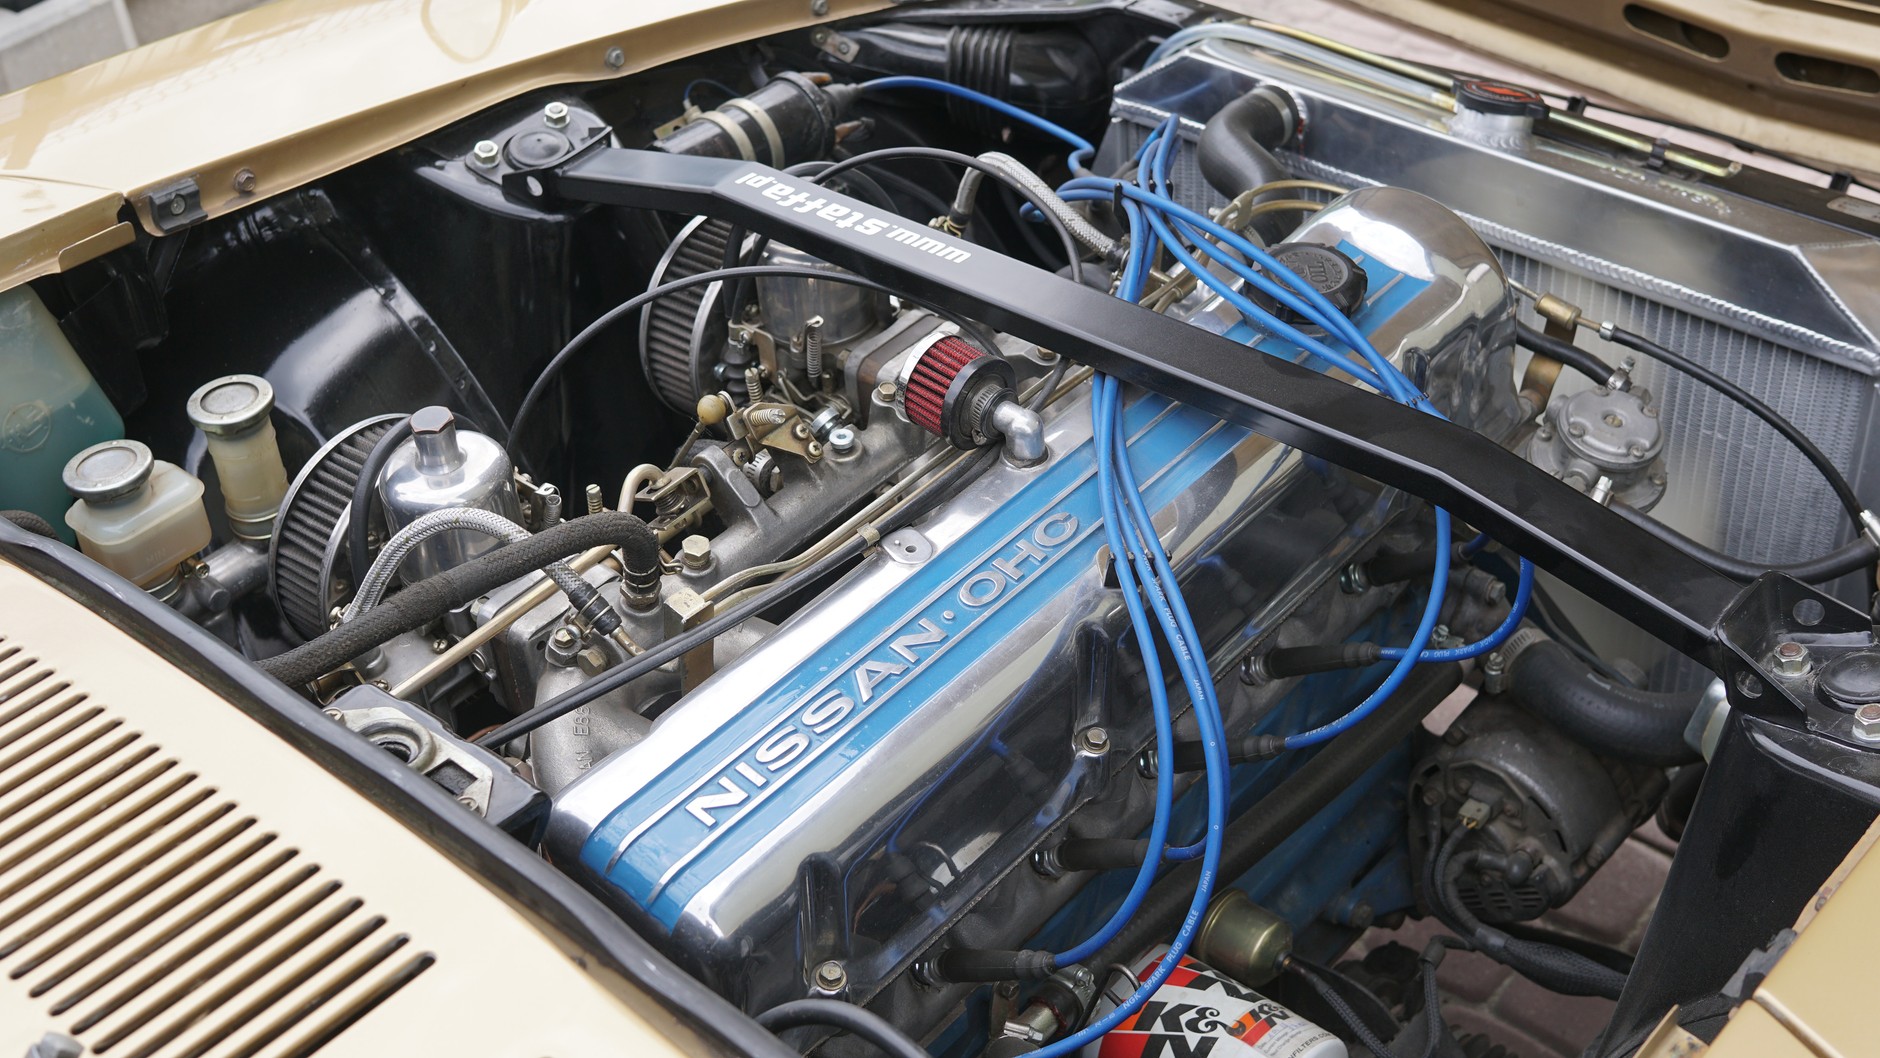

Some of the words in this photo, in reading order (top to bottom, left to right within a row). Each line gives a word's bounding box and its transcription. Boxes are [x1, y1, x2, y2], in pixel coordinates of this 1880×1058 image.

[685, 617, 949, 828] NISSAN
[958, 511, 1081, 608] OHC
[1163, 607, 1178, 628] PLUG
[1175, 633, 1192, 661] CABLE
[1193, 679, 1205, 701] JAPAN
[1122, 992, 1141, 1010] NGK
[1144, 965, 1166, 991] SPARK
[1166, 941, 1183, 963] PLUG
[1182, 909, 1199, 937] CABLE
[1201, 870, 1212, 892] JAPAN
